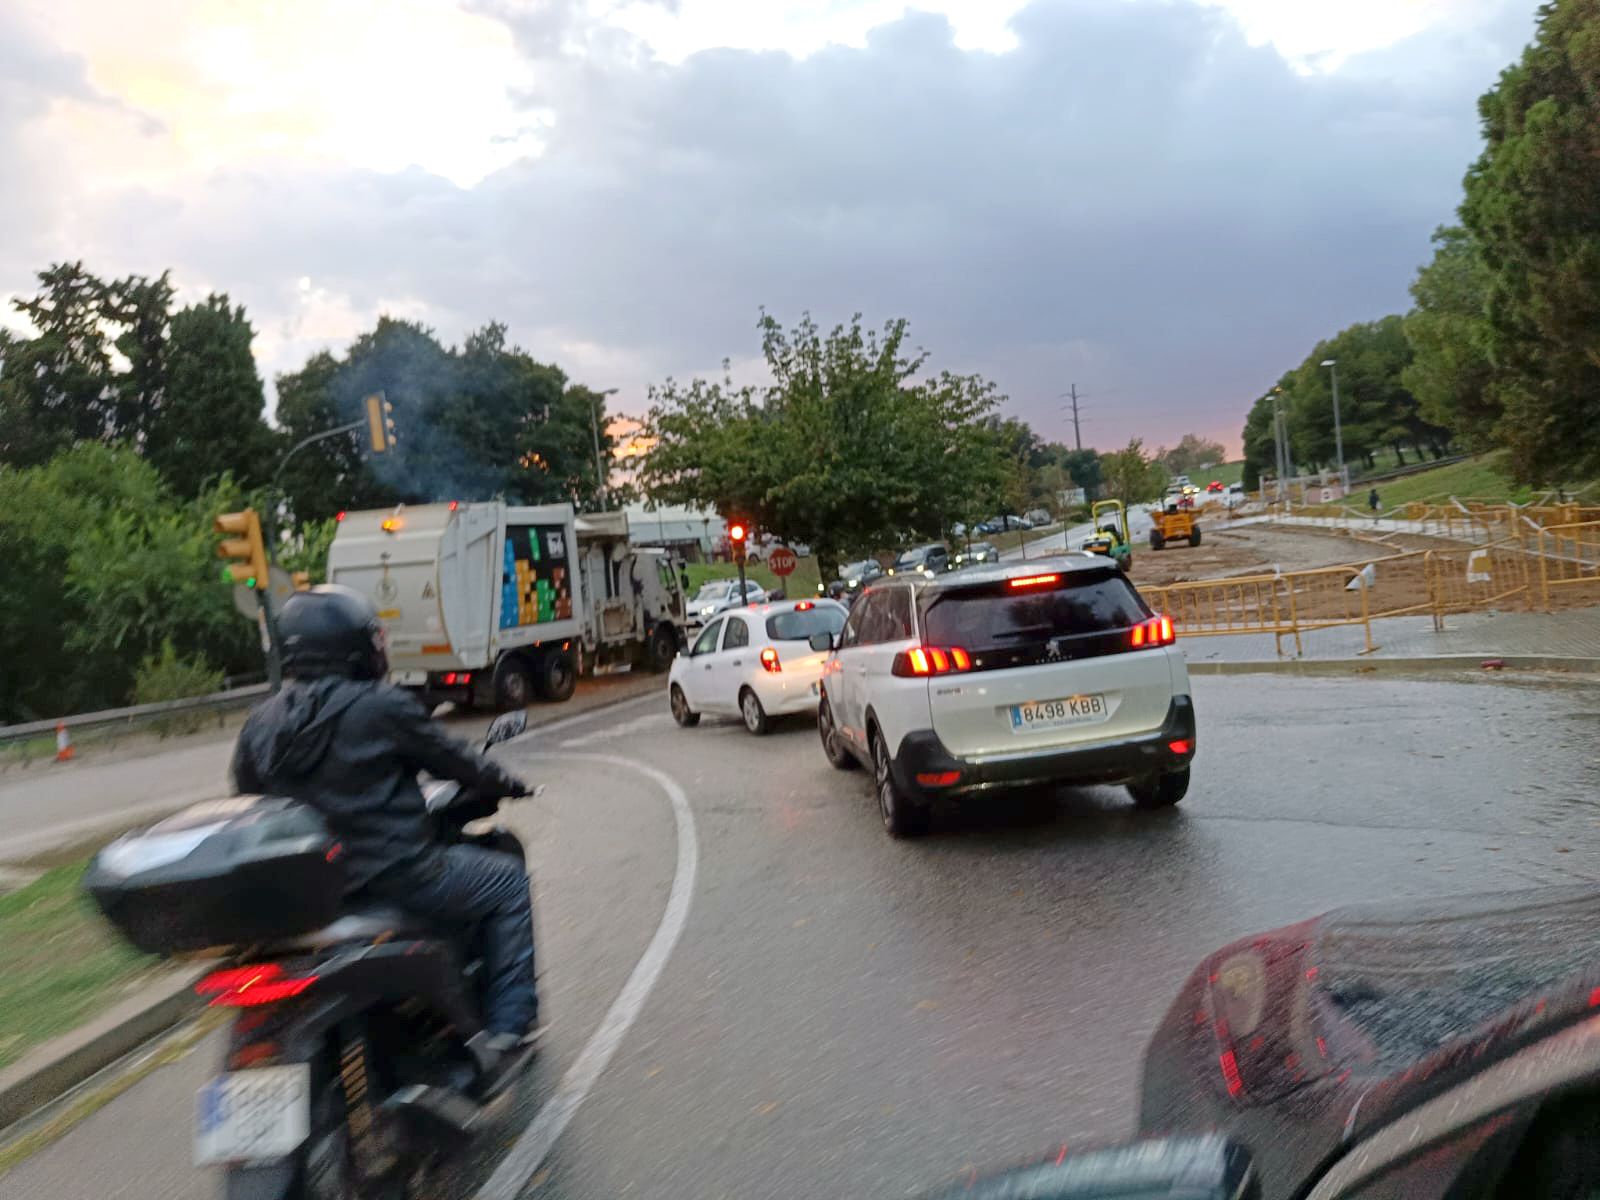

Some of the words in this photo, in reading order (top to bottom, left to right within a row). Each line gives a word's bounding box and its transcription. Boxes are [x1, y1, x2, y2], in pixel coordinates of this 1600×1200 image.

[769, 556, 795, 569] STOP
[1023, 703, 1065, 722] 8498
[1069, 698, 1101, 716] KBB
